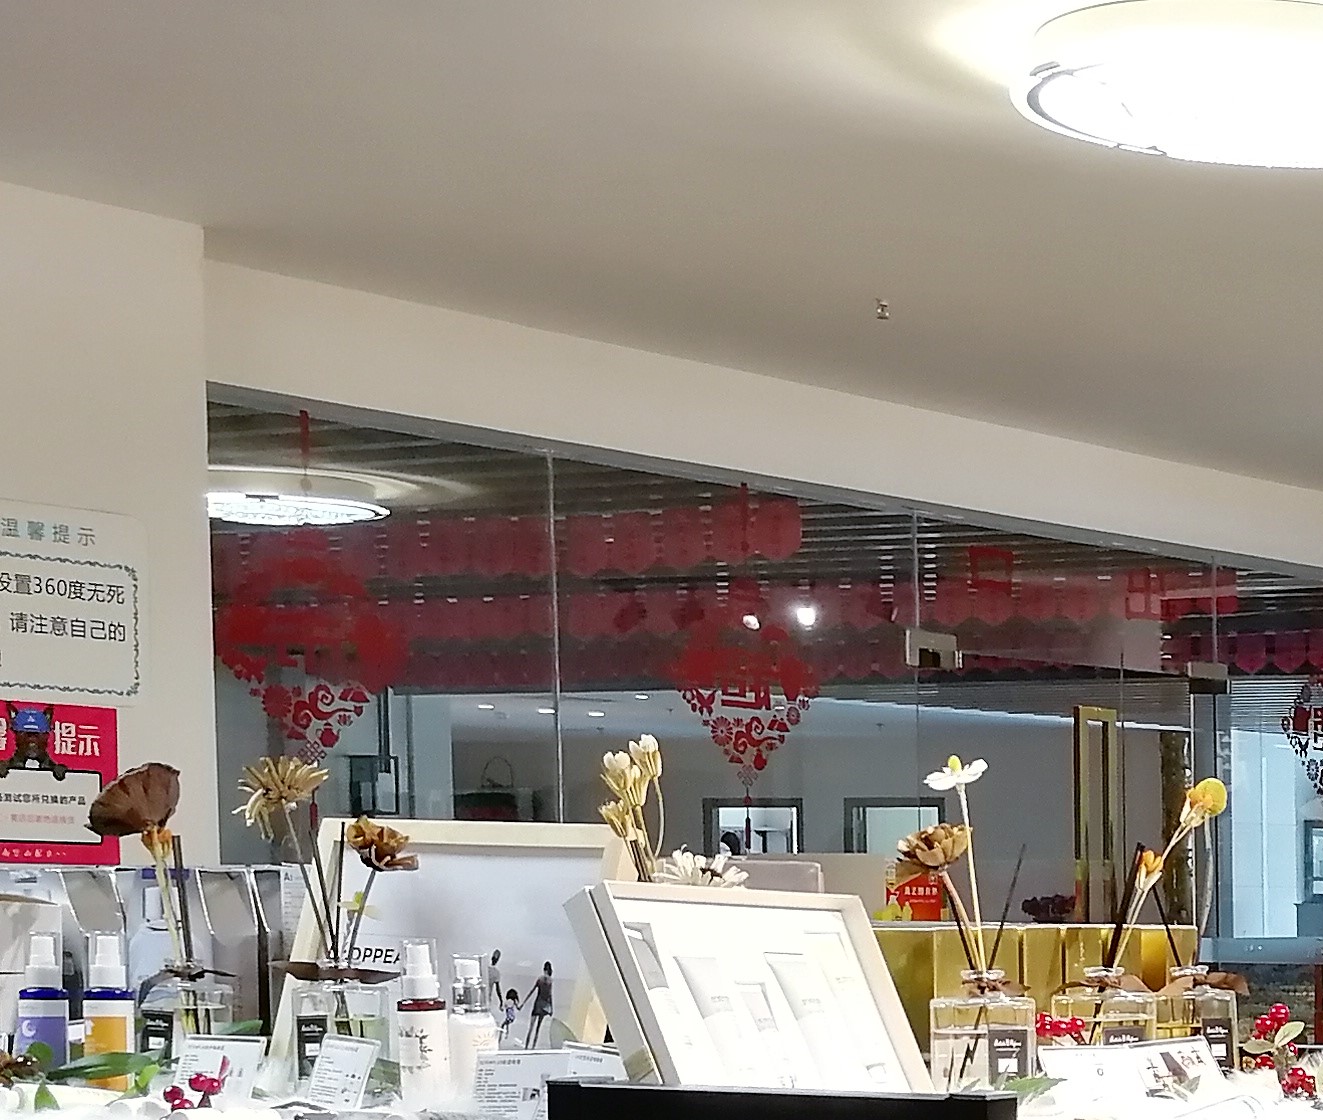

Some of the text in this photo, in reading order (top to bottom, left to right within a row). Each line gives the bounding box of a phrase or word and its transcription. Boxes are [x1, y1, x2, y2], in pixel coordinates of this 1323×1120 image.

[10, 612, 126, 642] 请注意自己的
[54, 721, 100, 757] 提示
